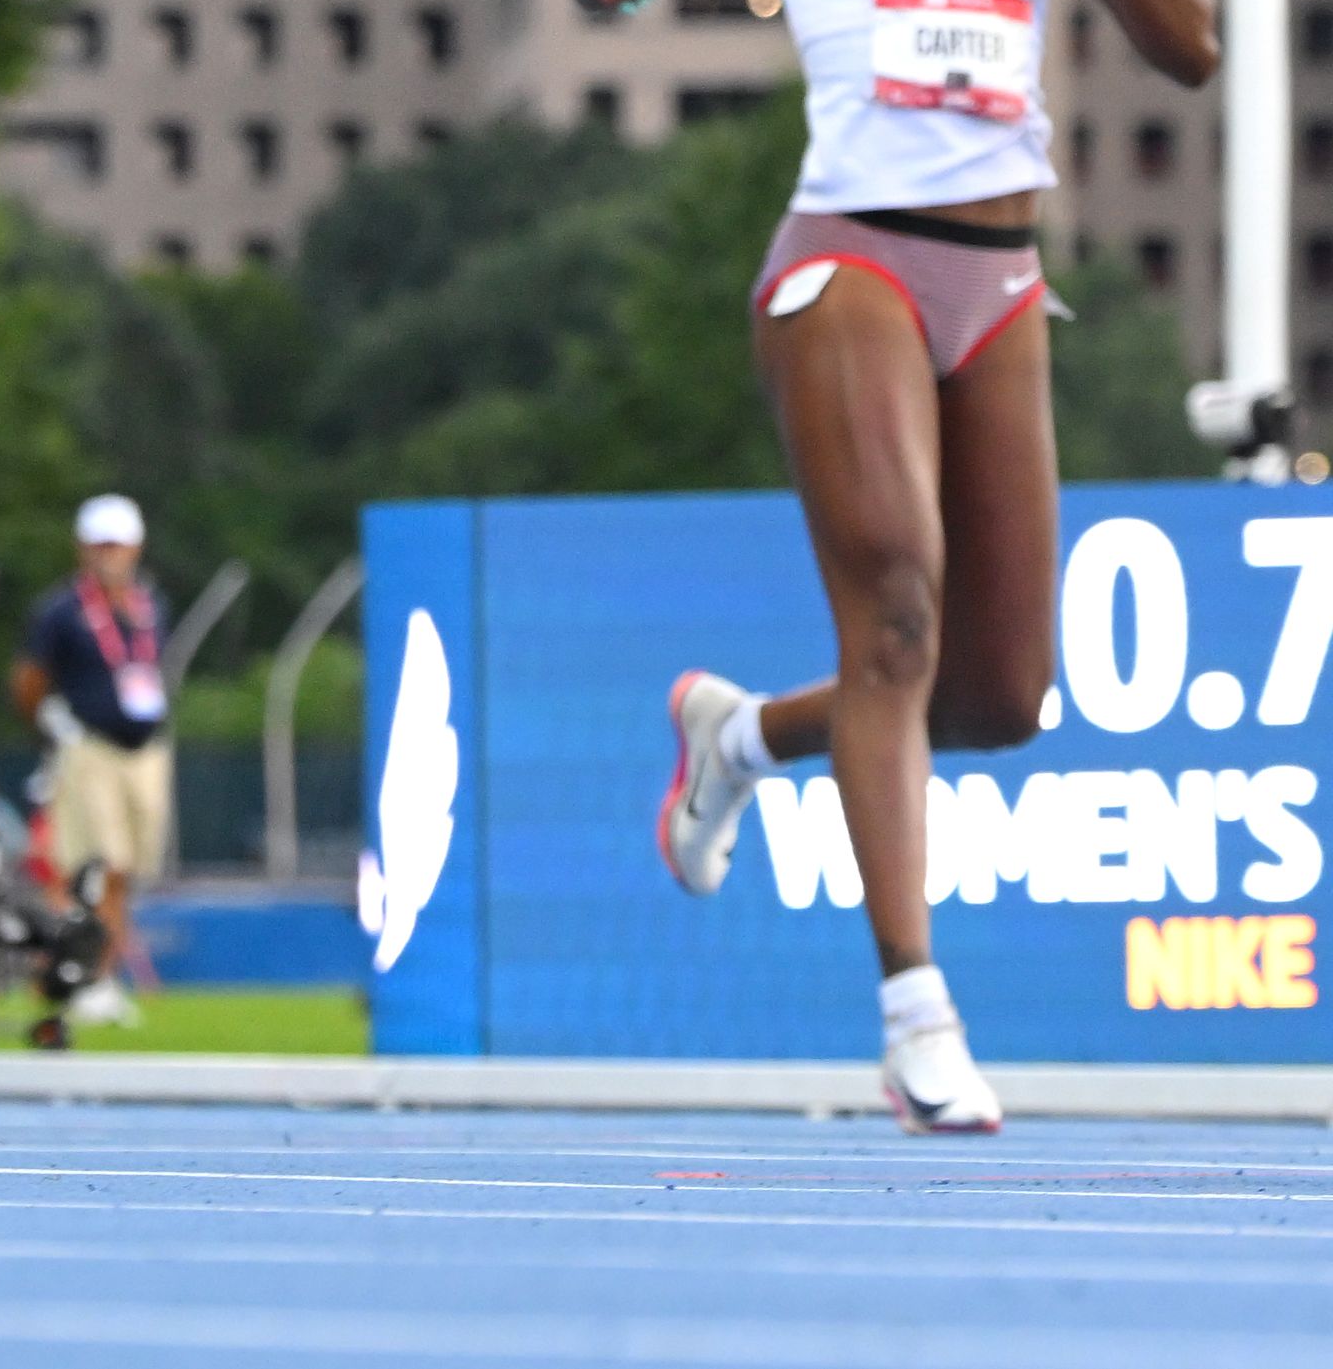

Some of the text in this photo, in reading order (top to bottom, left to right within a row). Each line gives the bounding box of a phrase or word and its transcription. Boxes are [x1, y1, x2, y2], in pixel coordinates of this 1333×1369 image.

[916, 28, 1007, 63] CARTER
[1038, 516, 1333, 734] 0.7
[1125, 914, 1319, 1011] NIKE
